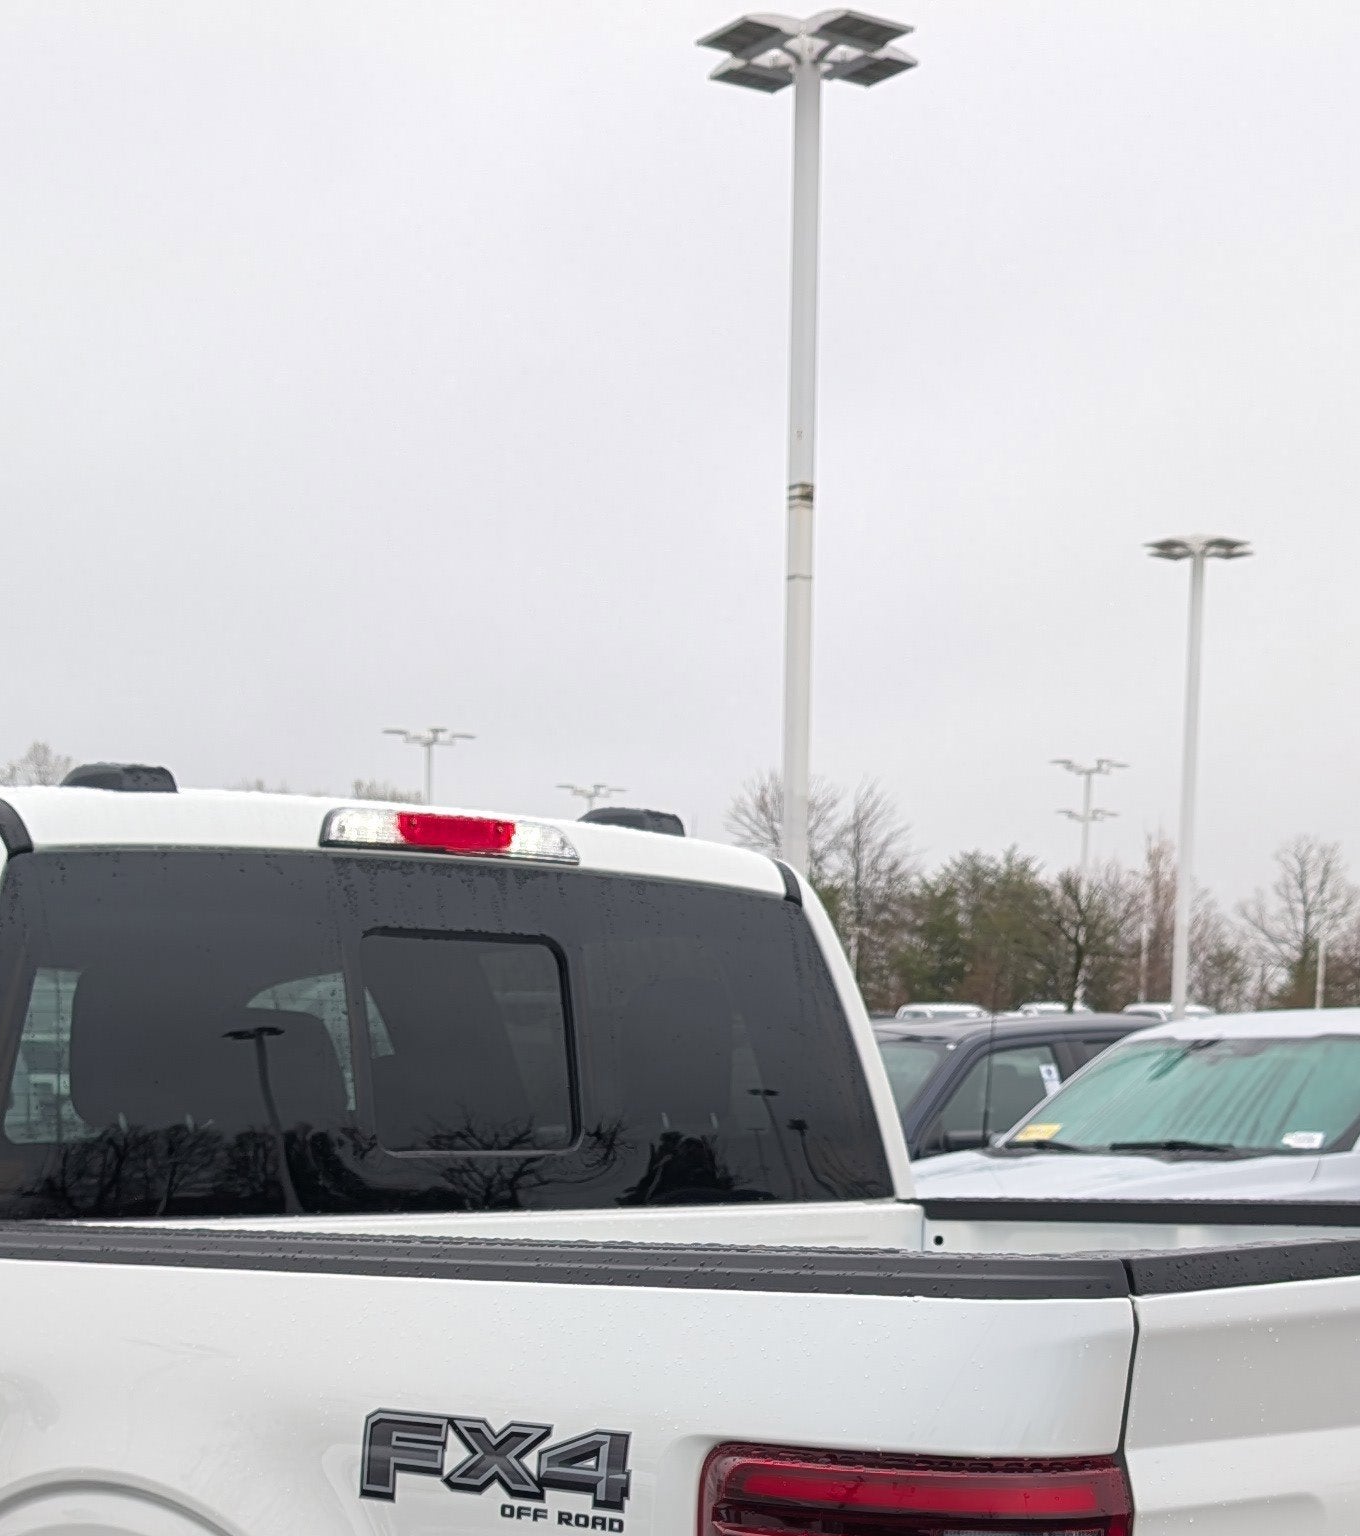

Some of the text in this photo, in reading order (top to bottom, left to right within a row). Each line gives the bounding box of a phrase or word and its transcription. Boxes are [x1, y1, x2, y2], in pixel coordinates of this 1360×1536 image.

[359, 1407, 632, 1513] FX4
[500, 1503, 625, 1533] OFF ROAD
